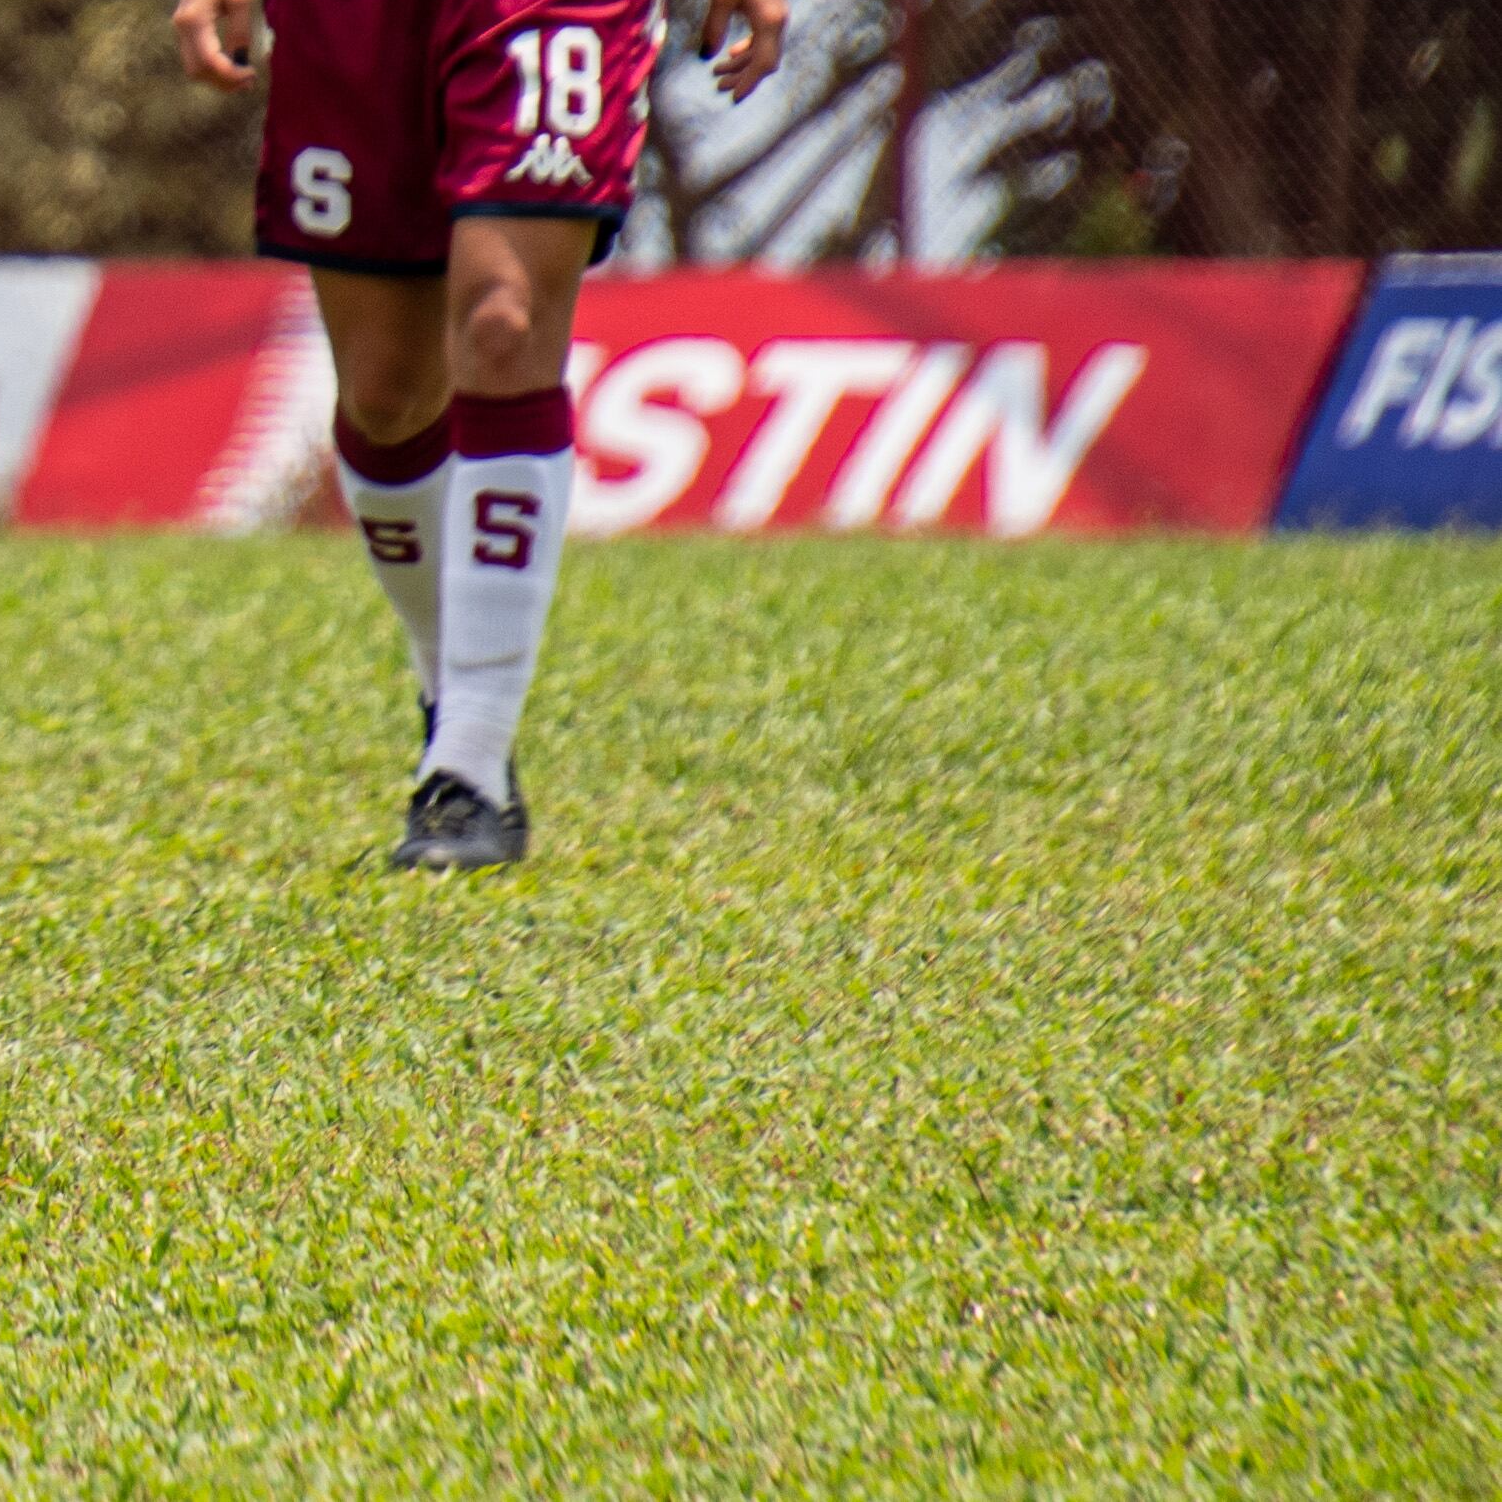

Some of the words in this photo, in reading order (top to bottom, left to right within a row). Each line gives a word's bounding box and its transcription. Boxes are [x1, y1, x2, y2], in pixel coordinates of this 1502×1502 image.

[507, 25, 603, 139] 18
[290, 147, 353, 238] S
[564, 332, 1149, 535] STIN
[474, 487, 542, 570] S
